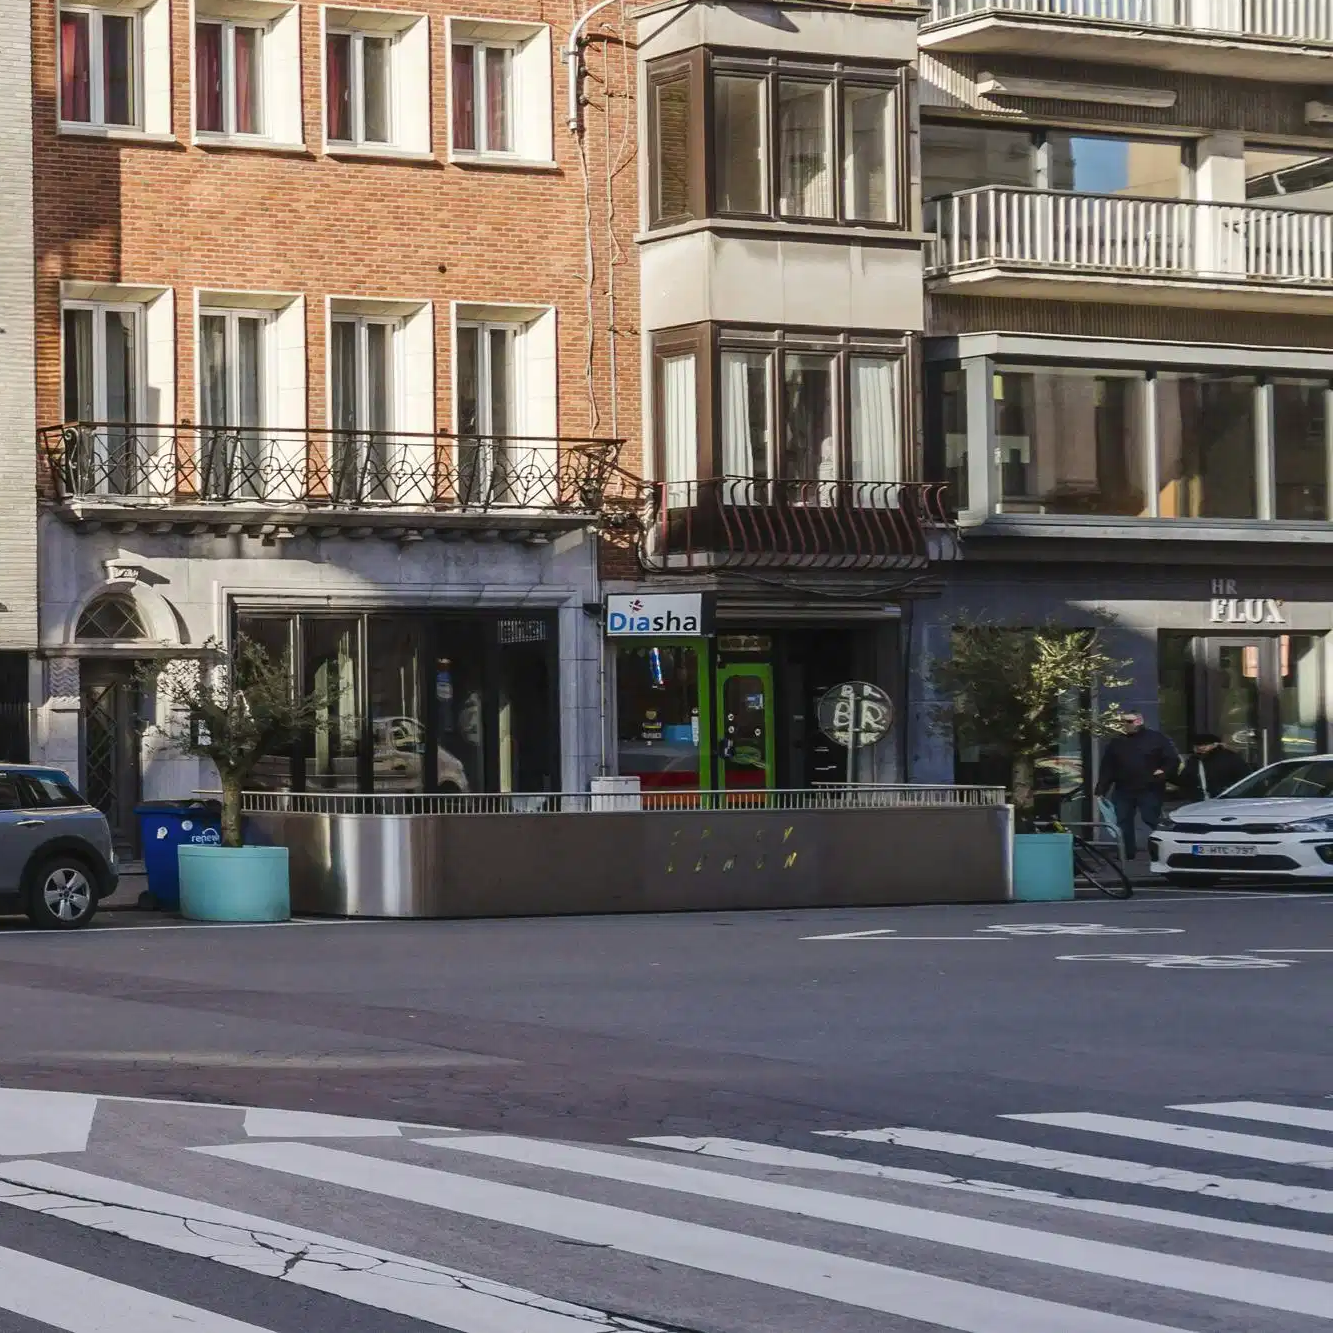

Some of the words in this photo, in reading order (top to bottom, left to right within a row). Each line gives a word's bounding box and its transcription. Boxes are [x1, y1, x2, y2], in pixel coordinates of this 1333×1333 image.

[1212, 578, 1237, 595] HR
[609, 610, 698, 632] Diasha
[1209, 598, 1286, 623] FLUX
